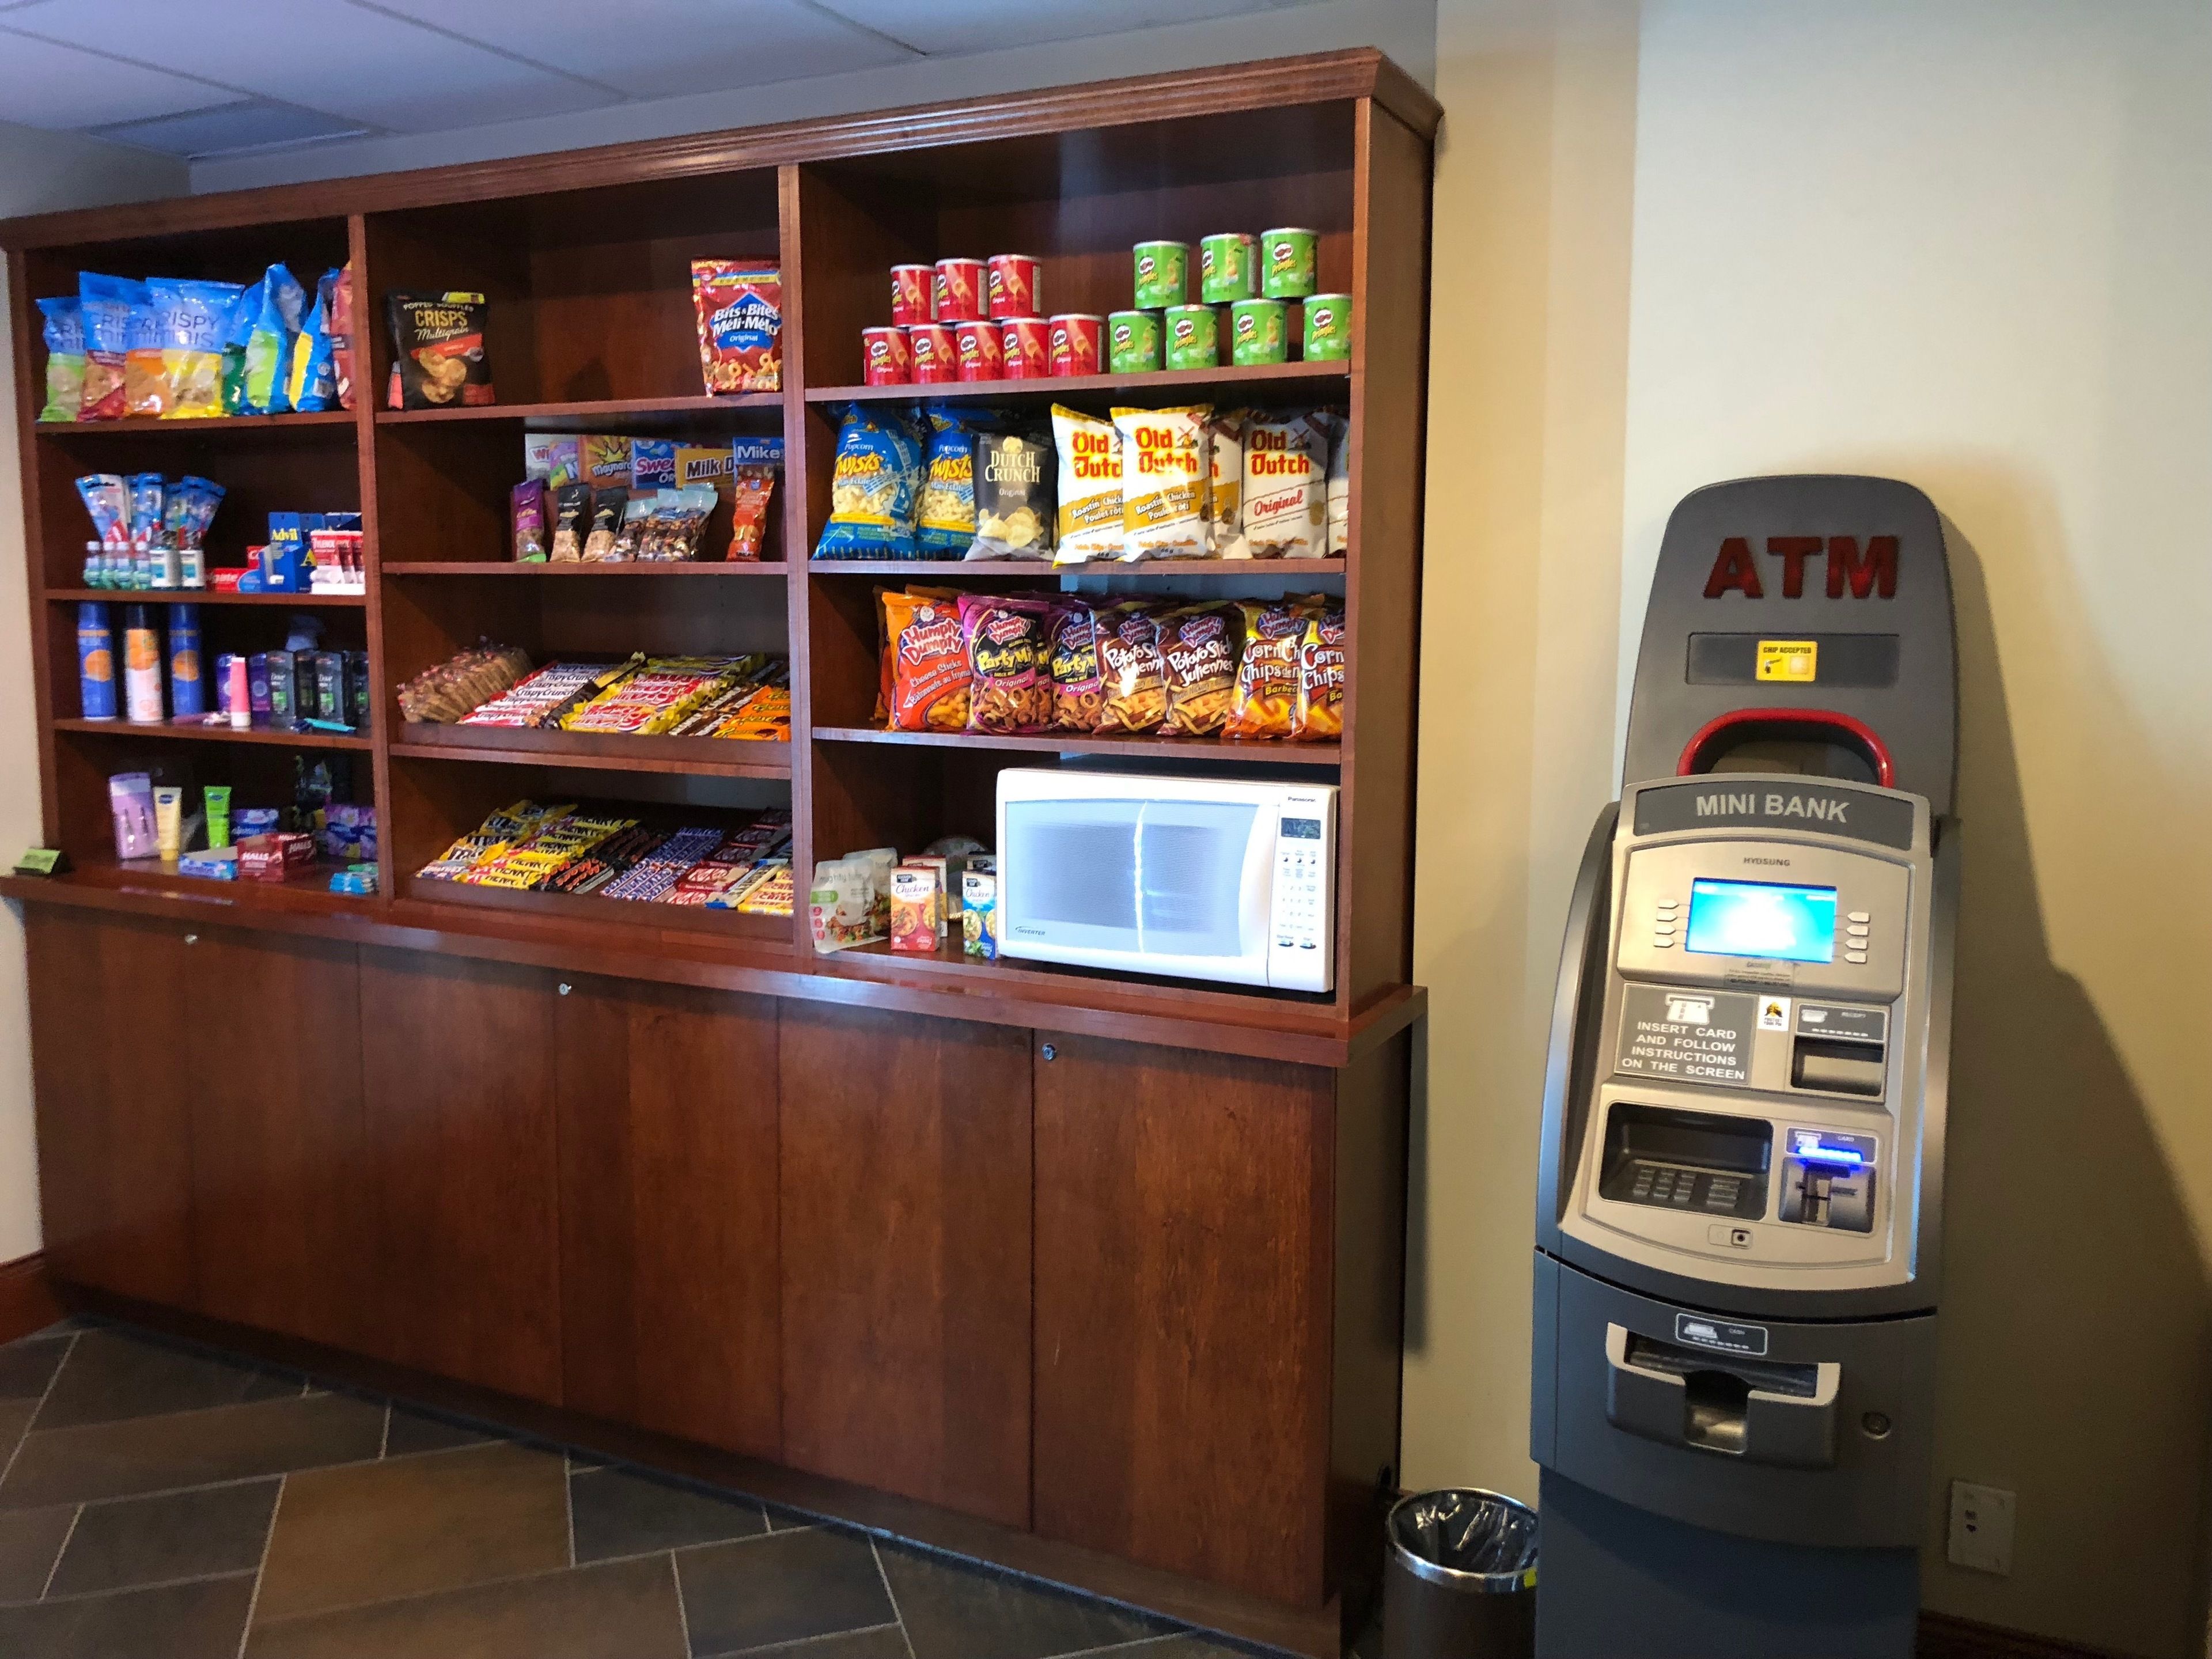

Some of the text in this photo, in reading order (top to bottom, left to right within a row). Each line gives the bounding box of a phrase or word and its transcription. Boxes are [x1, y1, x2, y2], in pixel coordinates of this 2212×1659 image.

[415, 310, 468, 327] CRISPS
[714, 307, 741, 322] Bits
[747, 304, 778, 320] Bites
[414, 327, 470, 342] Multigrain
[729, 333, 758, 343] Original
[844, 442, 874, 451] Popcorn
[1072, 431, 1109, 454] Old
[1136, 427, 1172, 449] Old
[1252, 430, 1286, 450] Old
[737, 446, 780, 460] Mike
[939, 444, 968, 454] Popcorn
[686, 459, 721, 479] Milk
[990, 450, 1035, 469] DUTCH
[1139, 450, 1198, 474] Dutch
[1251, 454, 1310, 475] Dutch
[985, 465, 1040, 483] CRUNCH
[999, 488, 1025, 497] Original
[1167, 491, 1195, 502] Chicken
[1254, 490, 1303, 517] Original
[272, 528, 298, 541] Advil
[1703, 536, 1899, 599] ATM
[902, 618, 962, 646] Humpty
[988, 616, 1027, 632] Humpty
[990, 626, 1025, 645] Dumpty
[903, 635, 963, 665] Dumpty
[1105, 645, 1142, 669] Potato
[1167, 645, 1207, 673] Potato
[1243, 637, 1282, 663] Corn
[1301, 643, 1344, 670] Corn
[977, 650, 1016, 671] Party
[1052, 655, 1087, 677] Party
[910, 659, 962, 688] Cheese Sticks
[942, 676, 952, 684] au
[995, 676, 1028, 687] Original
[1241, 664, 1282, 684] Chips
[1302, 666, 1344, 690] Chips
[1696, 793, 1850, 824] MINI BANK
[289, 840, 312, 853] HALLS
[243, 853, 270, 861] HALLS
[1743, 857, 1790, 867] HYOSUNG
[896, 884, 930, 893] Chicken
[965, 888, 990, 897] Chicken
[1637, 1021, 1737, 1040] INSERT CARD
[1636, 1035, 1736, 1052] AND FOLLOW
[1631, 1046, 1737, 1066] INSTRUCTIONS
[1622, 1058, 1745, 1080] ON THE SCREEN
